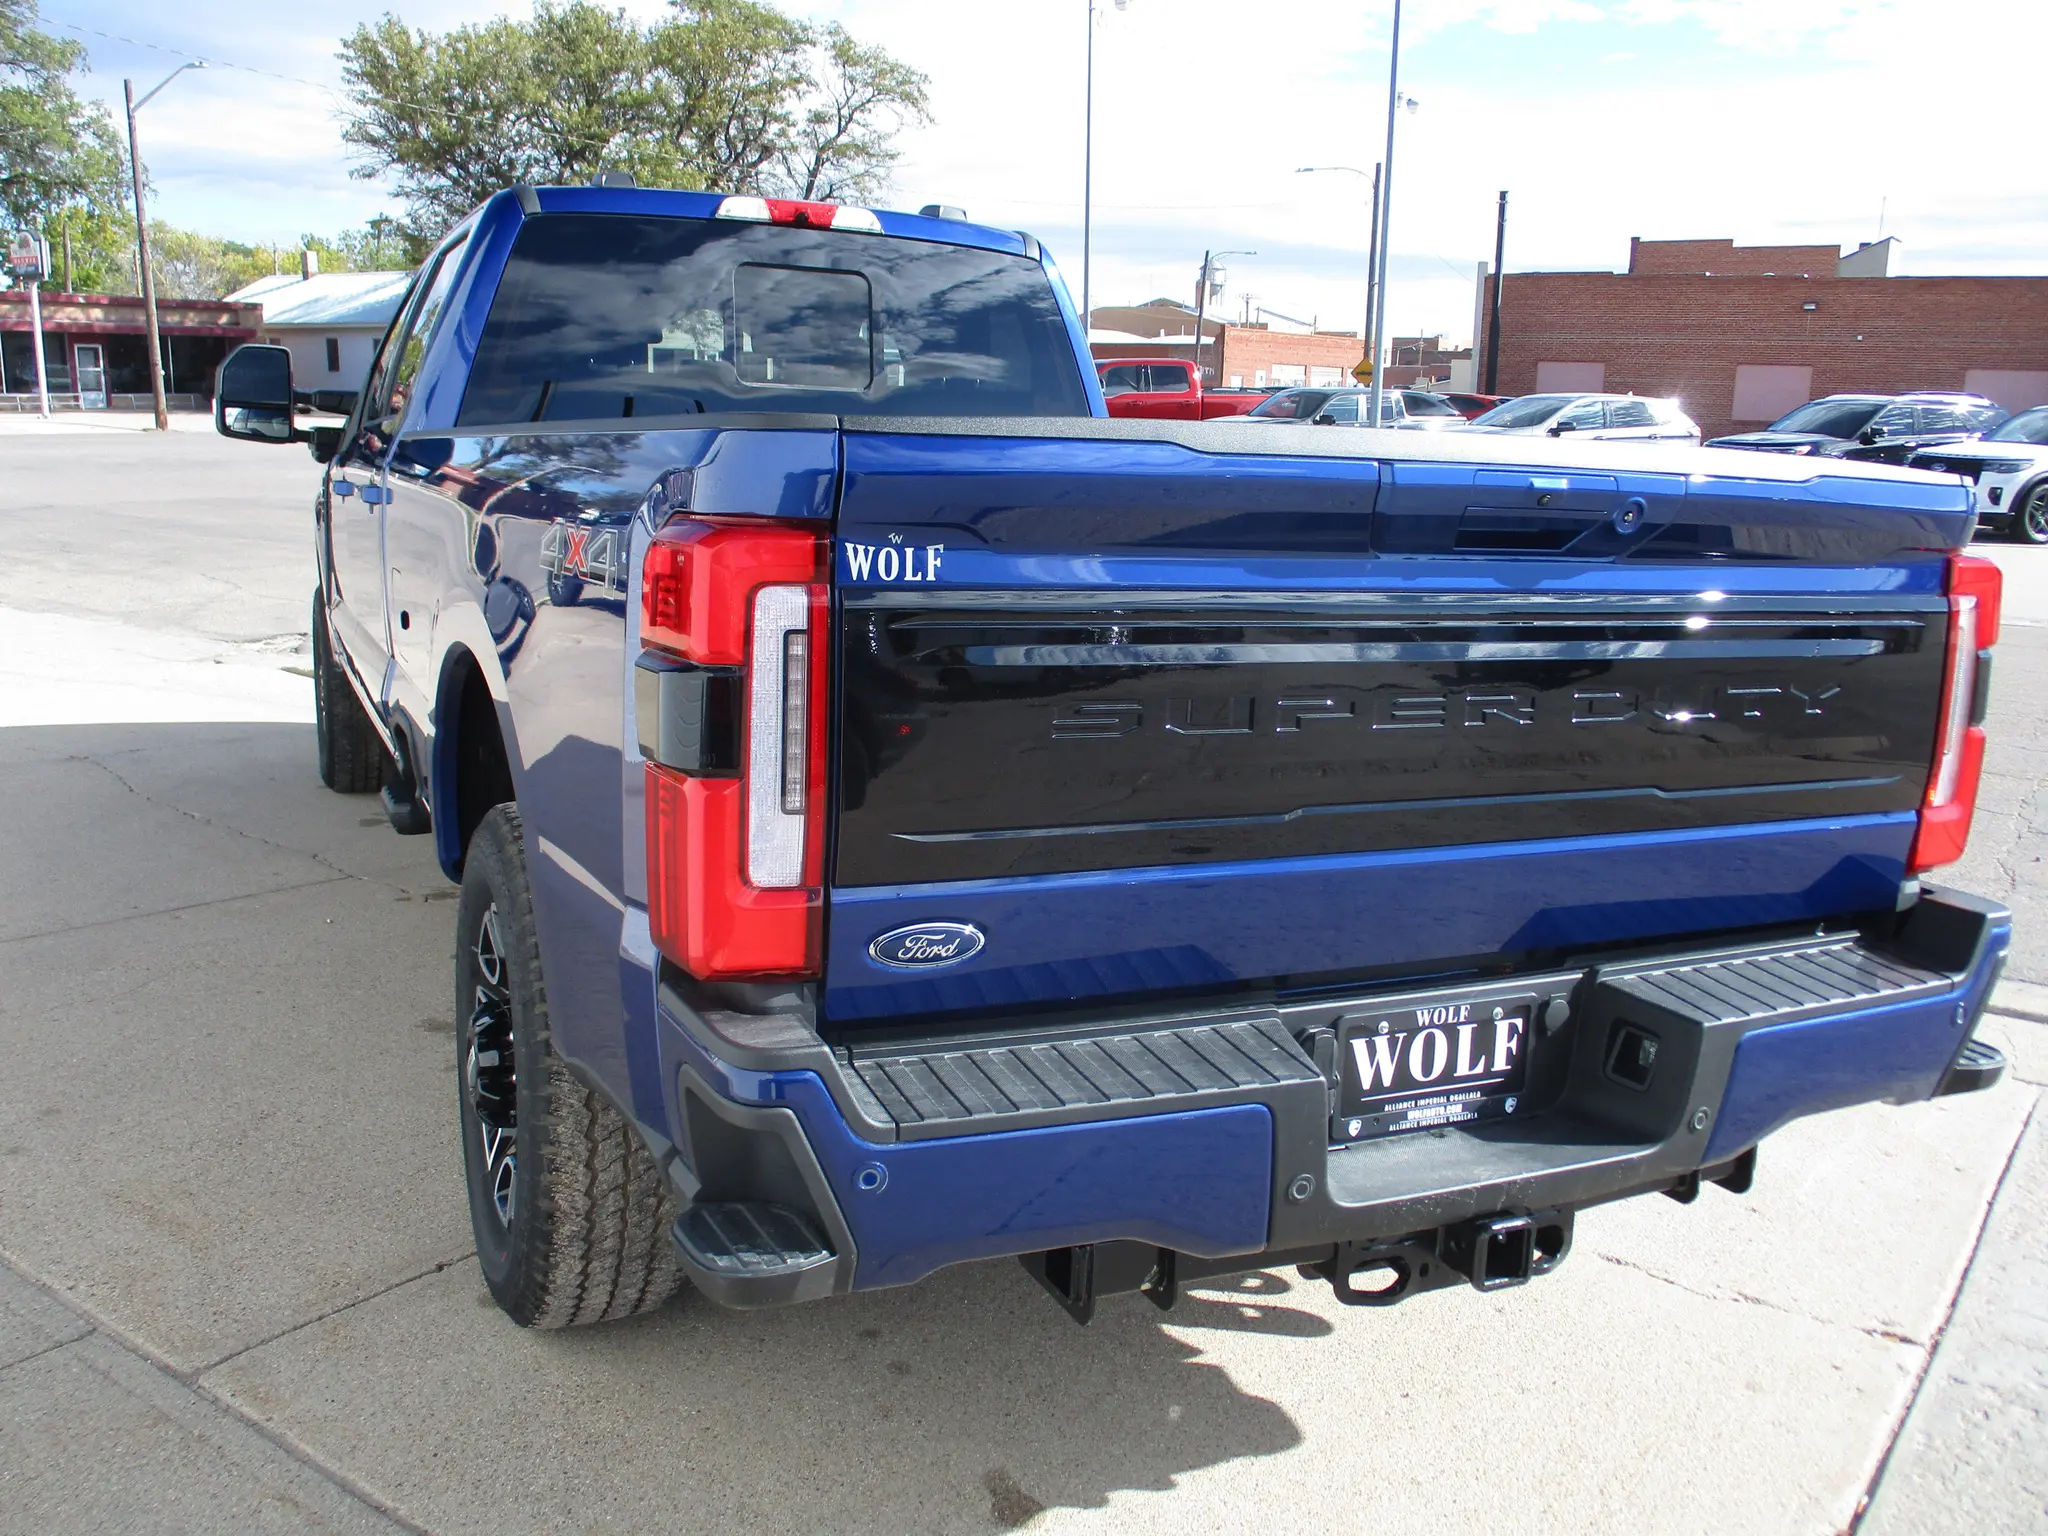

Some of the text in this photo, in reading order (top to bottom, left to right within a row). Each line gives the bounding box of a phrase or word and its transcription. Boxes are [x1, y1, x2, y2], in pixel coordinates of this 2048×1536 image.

[844, 542, 944, 581] WOLF
[1052, 683, 1842, 739] SUPER DUTY
[898, 934, 960, 960] Ford
[1416, 1004, 1471, 1027] WOLF
[1350, 1018, 1523, 1090] WOLF
[1384, 1100, 1416, 1112] ALLIANCE
[1417, 1096, 1448, 1107] IMPERIAL
[1389, 1121, 1418, 1132] ALLIANCE
[1419, 1115, 1448, 1127] IMPERIAL
